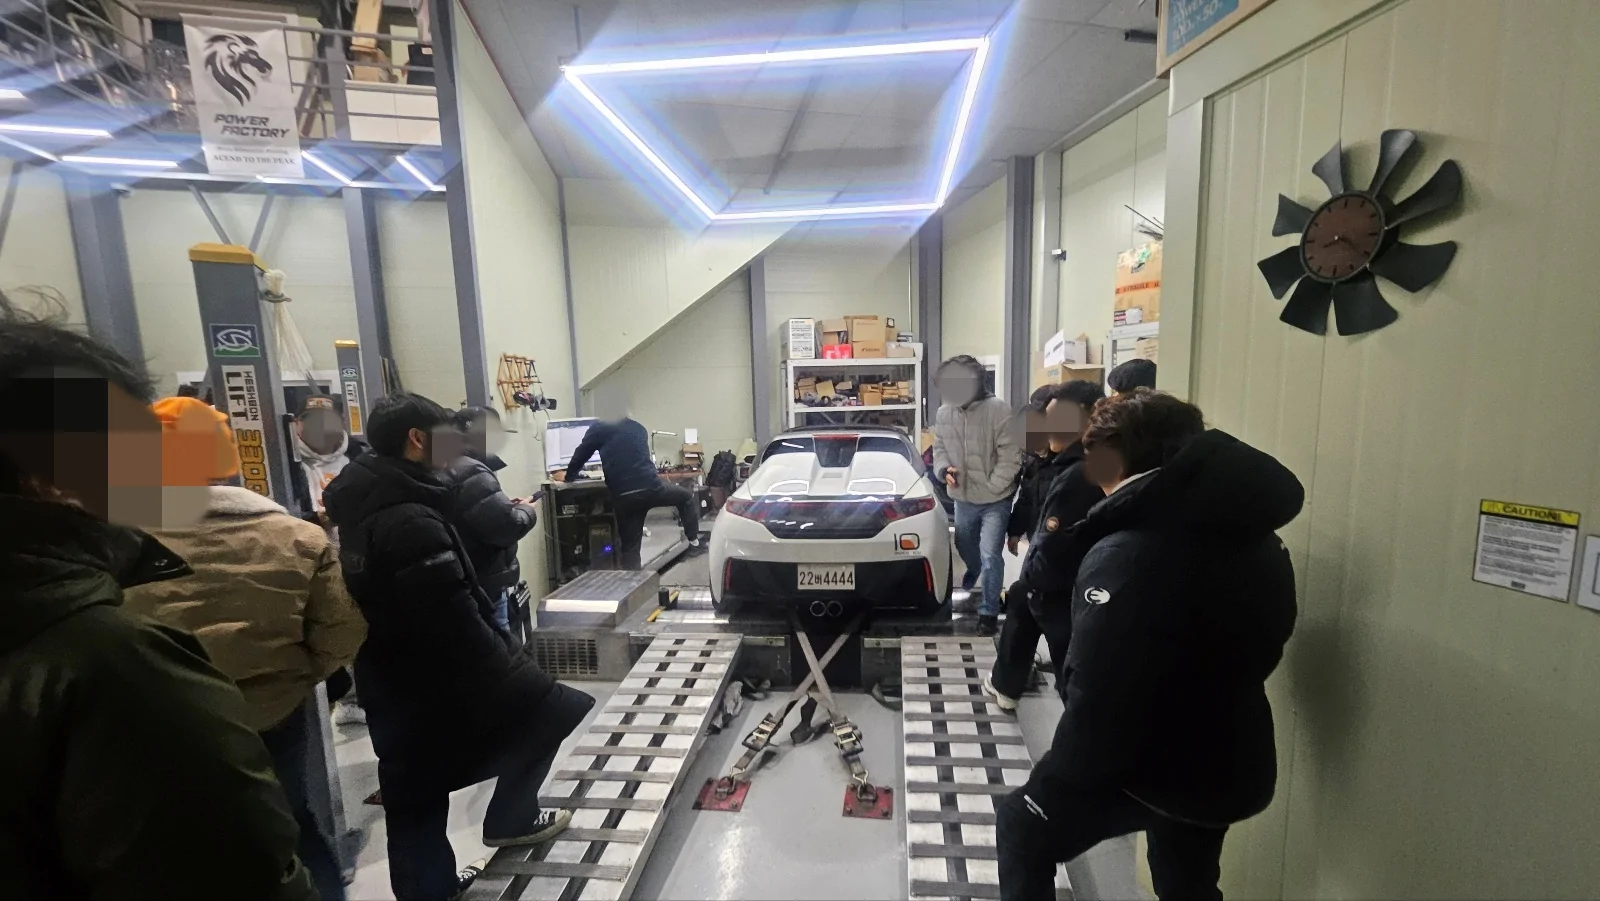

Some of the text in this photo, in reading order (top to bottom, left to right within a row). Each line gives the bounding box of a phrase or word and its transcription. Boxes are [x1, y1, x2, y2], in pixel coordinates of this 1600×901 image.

[214, 113, 270, 126] POWER
[221, 125, 290, 137] FACTORY
[244, 156, 255, 164] TO
[257, 156, 271, 164] THE
[273, 156, 296, 165] PEAK
[243, 371, 260, 421] HESHBON
[226, 372, 269, 497] LIFT 3300
